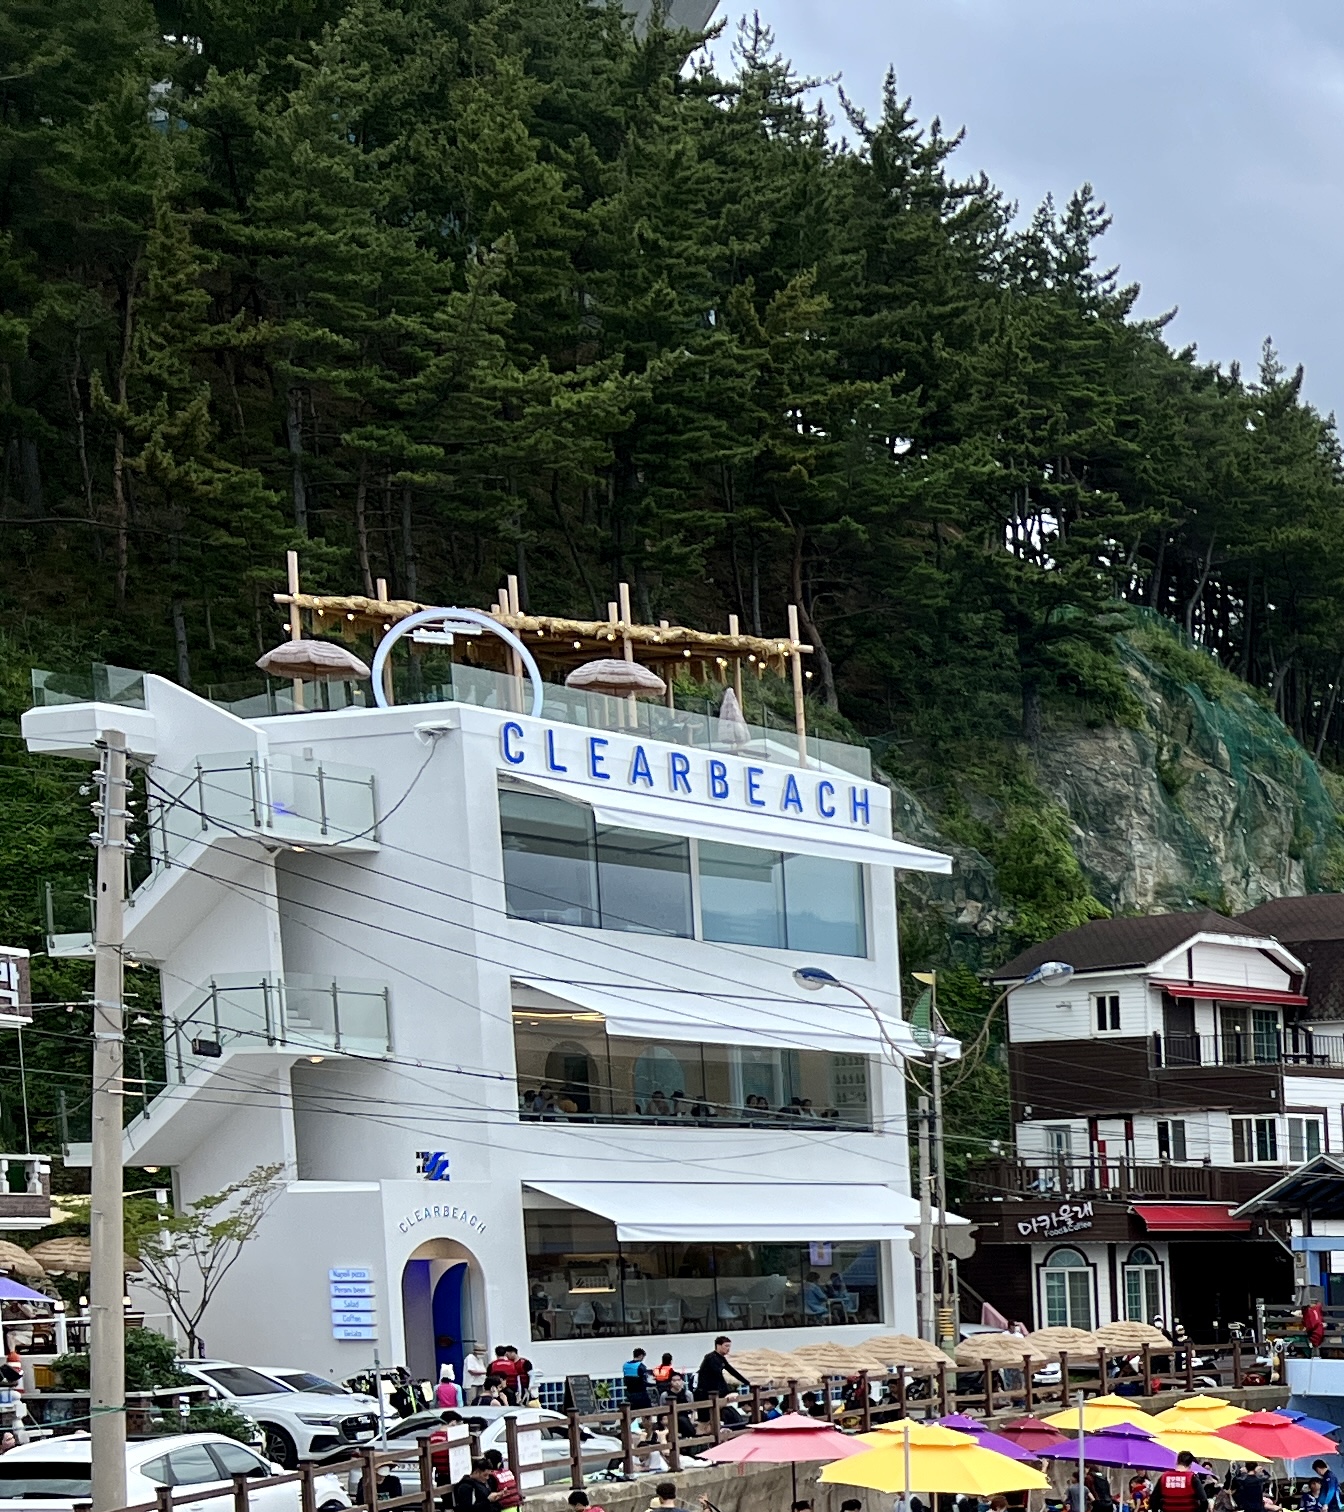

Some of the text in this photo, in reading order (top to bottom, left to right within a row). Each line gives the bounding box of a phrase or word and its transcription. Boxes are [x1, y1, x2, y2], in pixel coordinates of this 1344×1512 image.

[500, 721, 871, 825] CLEARBEACH
[398, 1205, 487, 1234] CLEARBEACH
[1017, 1201, 1094, 1236] 마카올래
[351, 1270, 366, 1279] pizza
[353, 1286, 366, 1294] beer
[343, 1300, 360, 1308] Salad
[342, 1314, 361, 1323] Coffee
